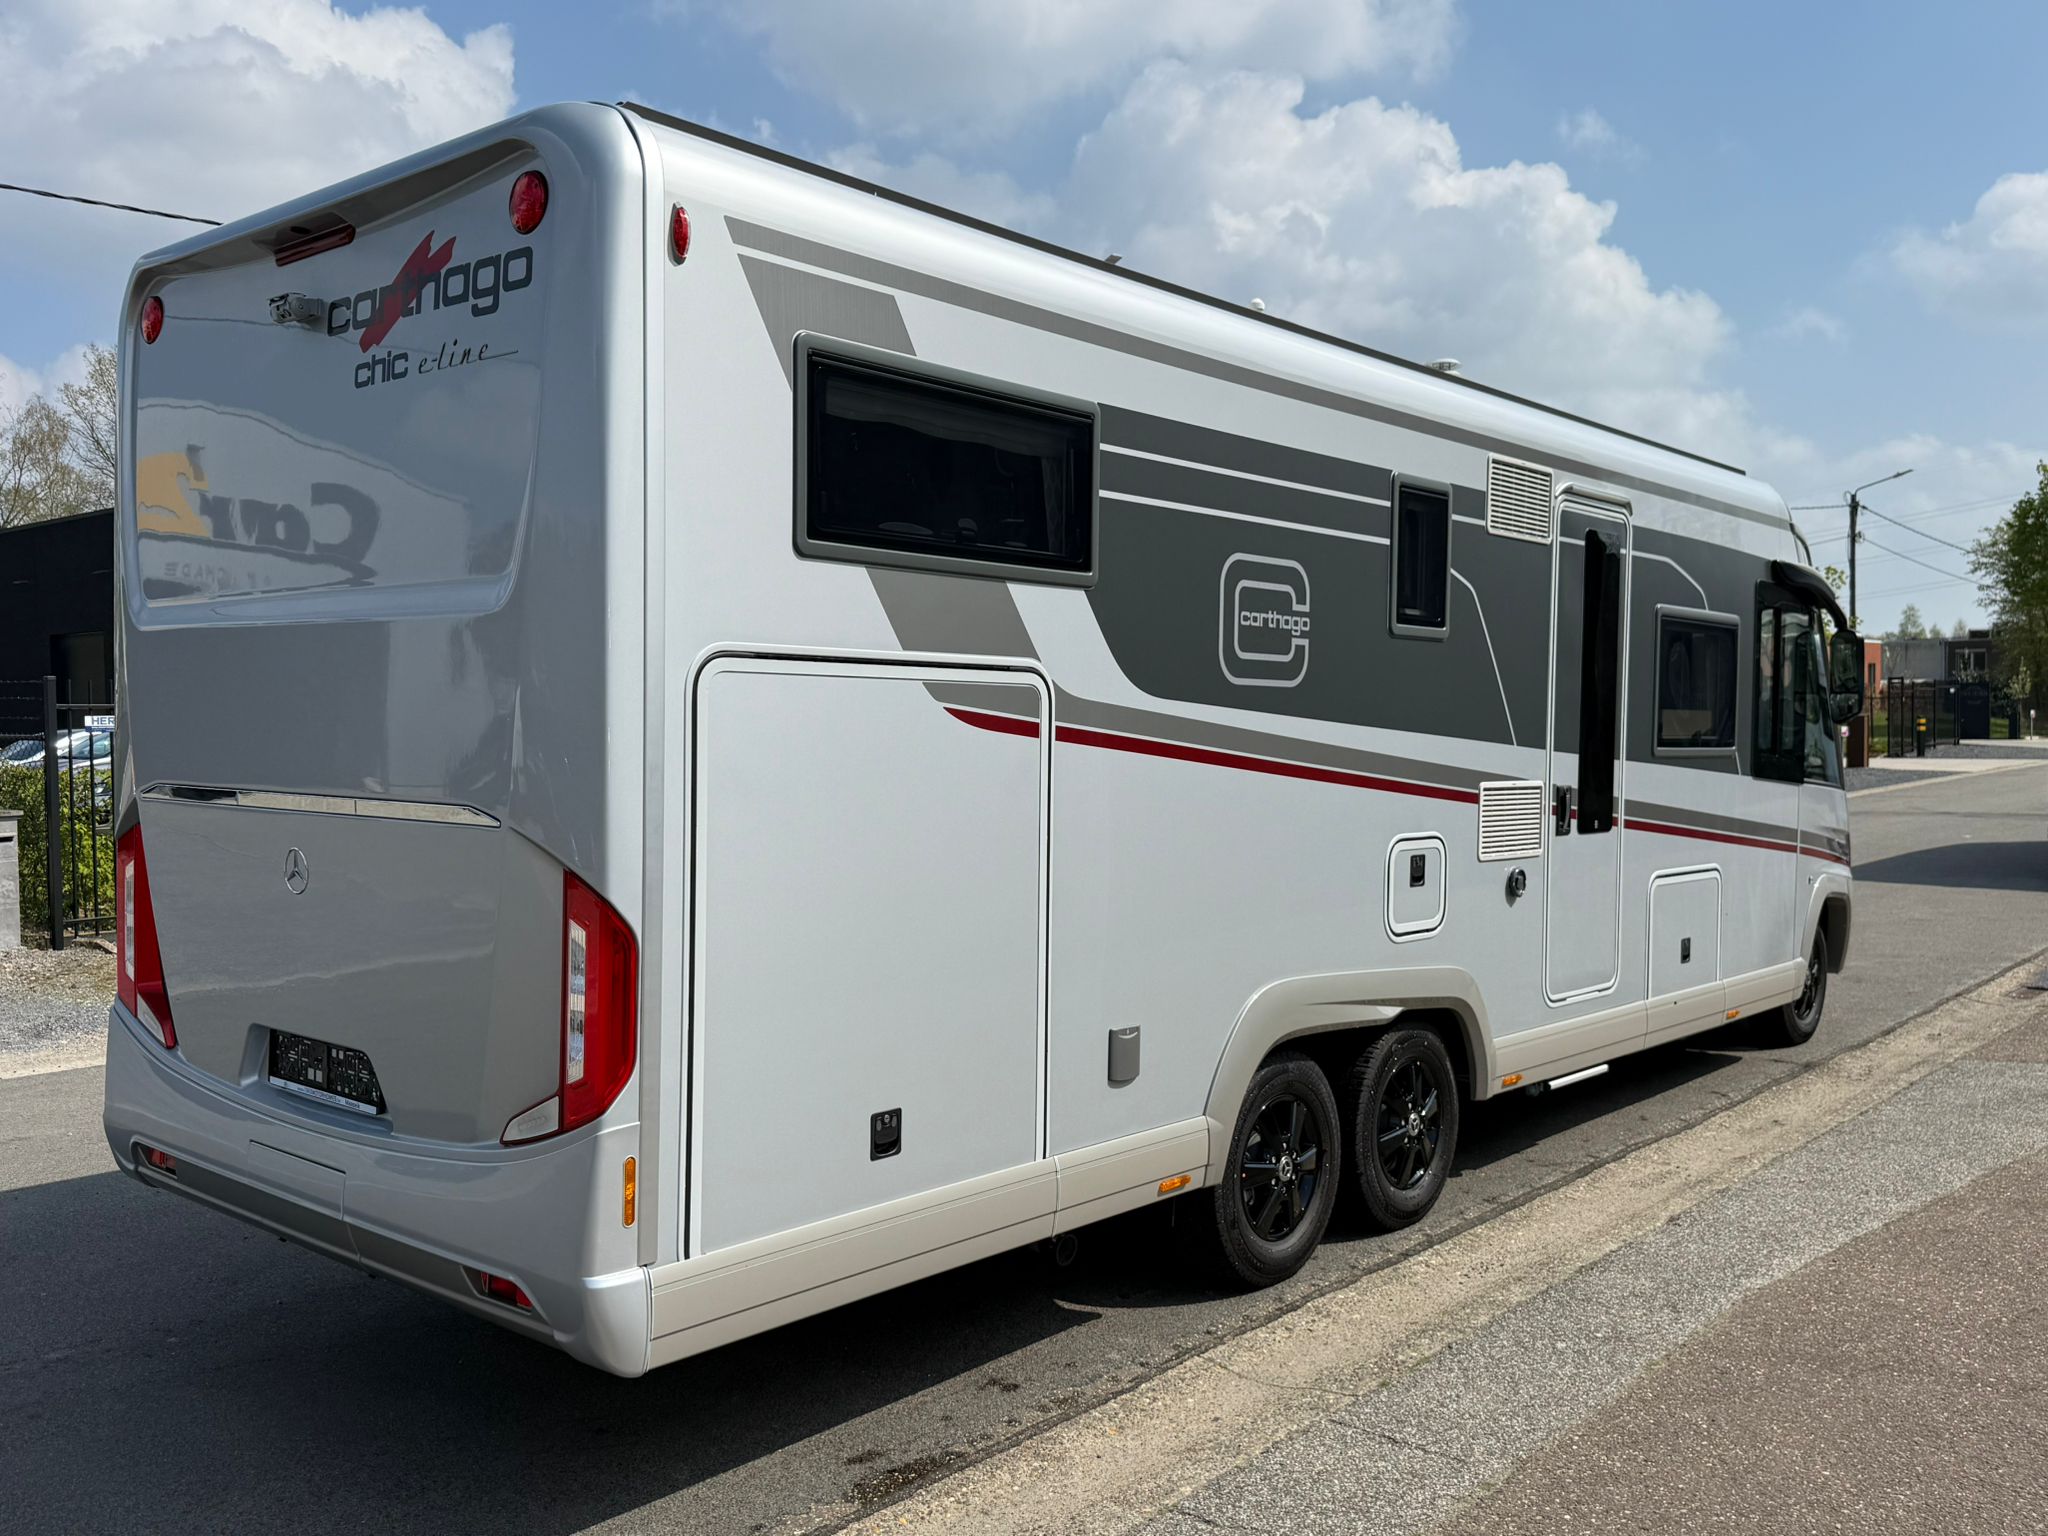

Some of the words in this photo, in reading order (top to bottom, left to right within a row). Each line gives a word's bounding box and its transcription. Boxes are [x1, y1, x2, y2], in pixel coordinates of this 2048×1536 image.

[327, 246, 533, 337] carthago
[354, 350, 409, 389] chic
[1240, 610, 1310, 636] carthago
